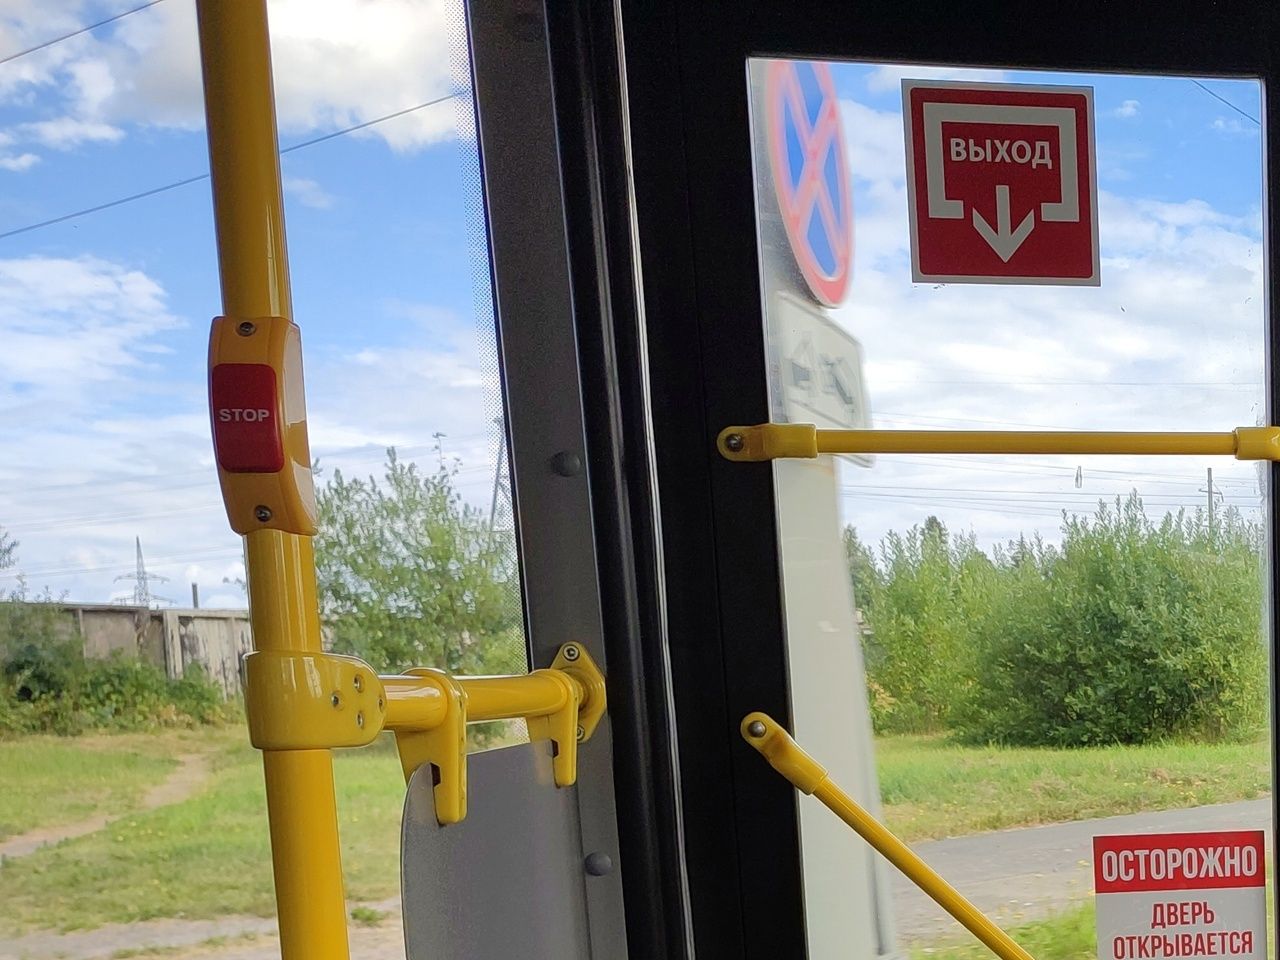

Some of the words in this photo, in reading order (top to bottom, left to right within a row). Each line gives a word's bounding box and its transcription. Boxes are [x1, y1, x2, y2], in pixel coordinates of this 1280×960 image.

[950, 137, 1053, 170] ВЫХОД
[219, 408, 271, 422] STOP
[1102, 845, 1257, 882] ОСТОРОЖНО
[1151, 901, 1215, 929] ДВЕРЬ
[1113, 930, 1253, 960] ОТКРЫВАЕТСЯ
